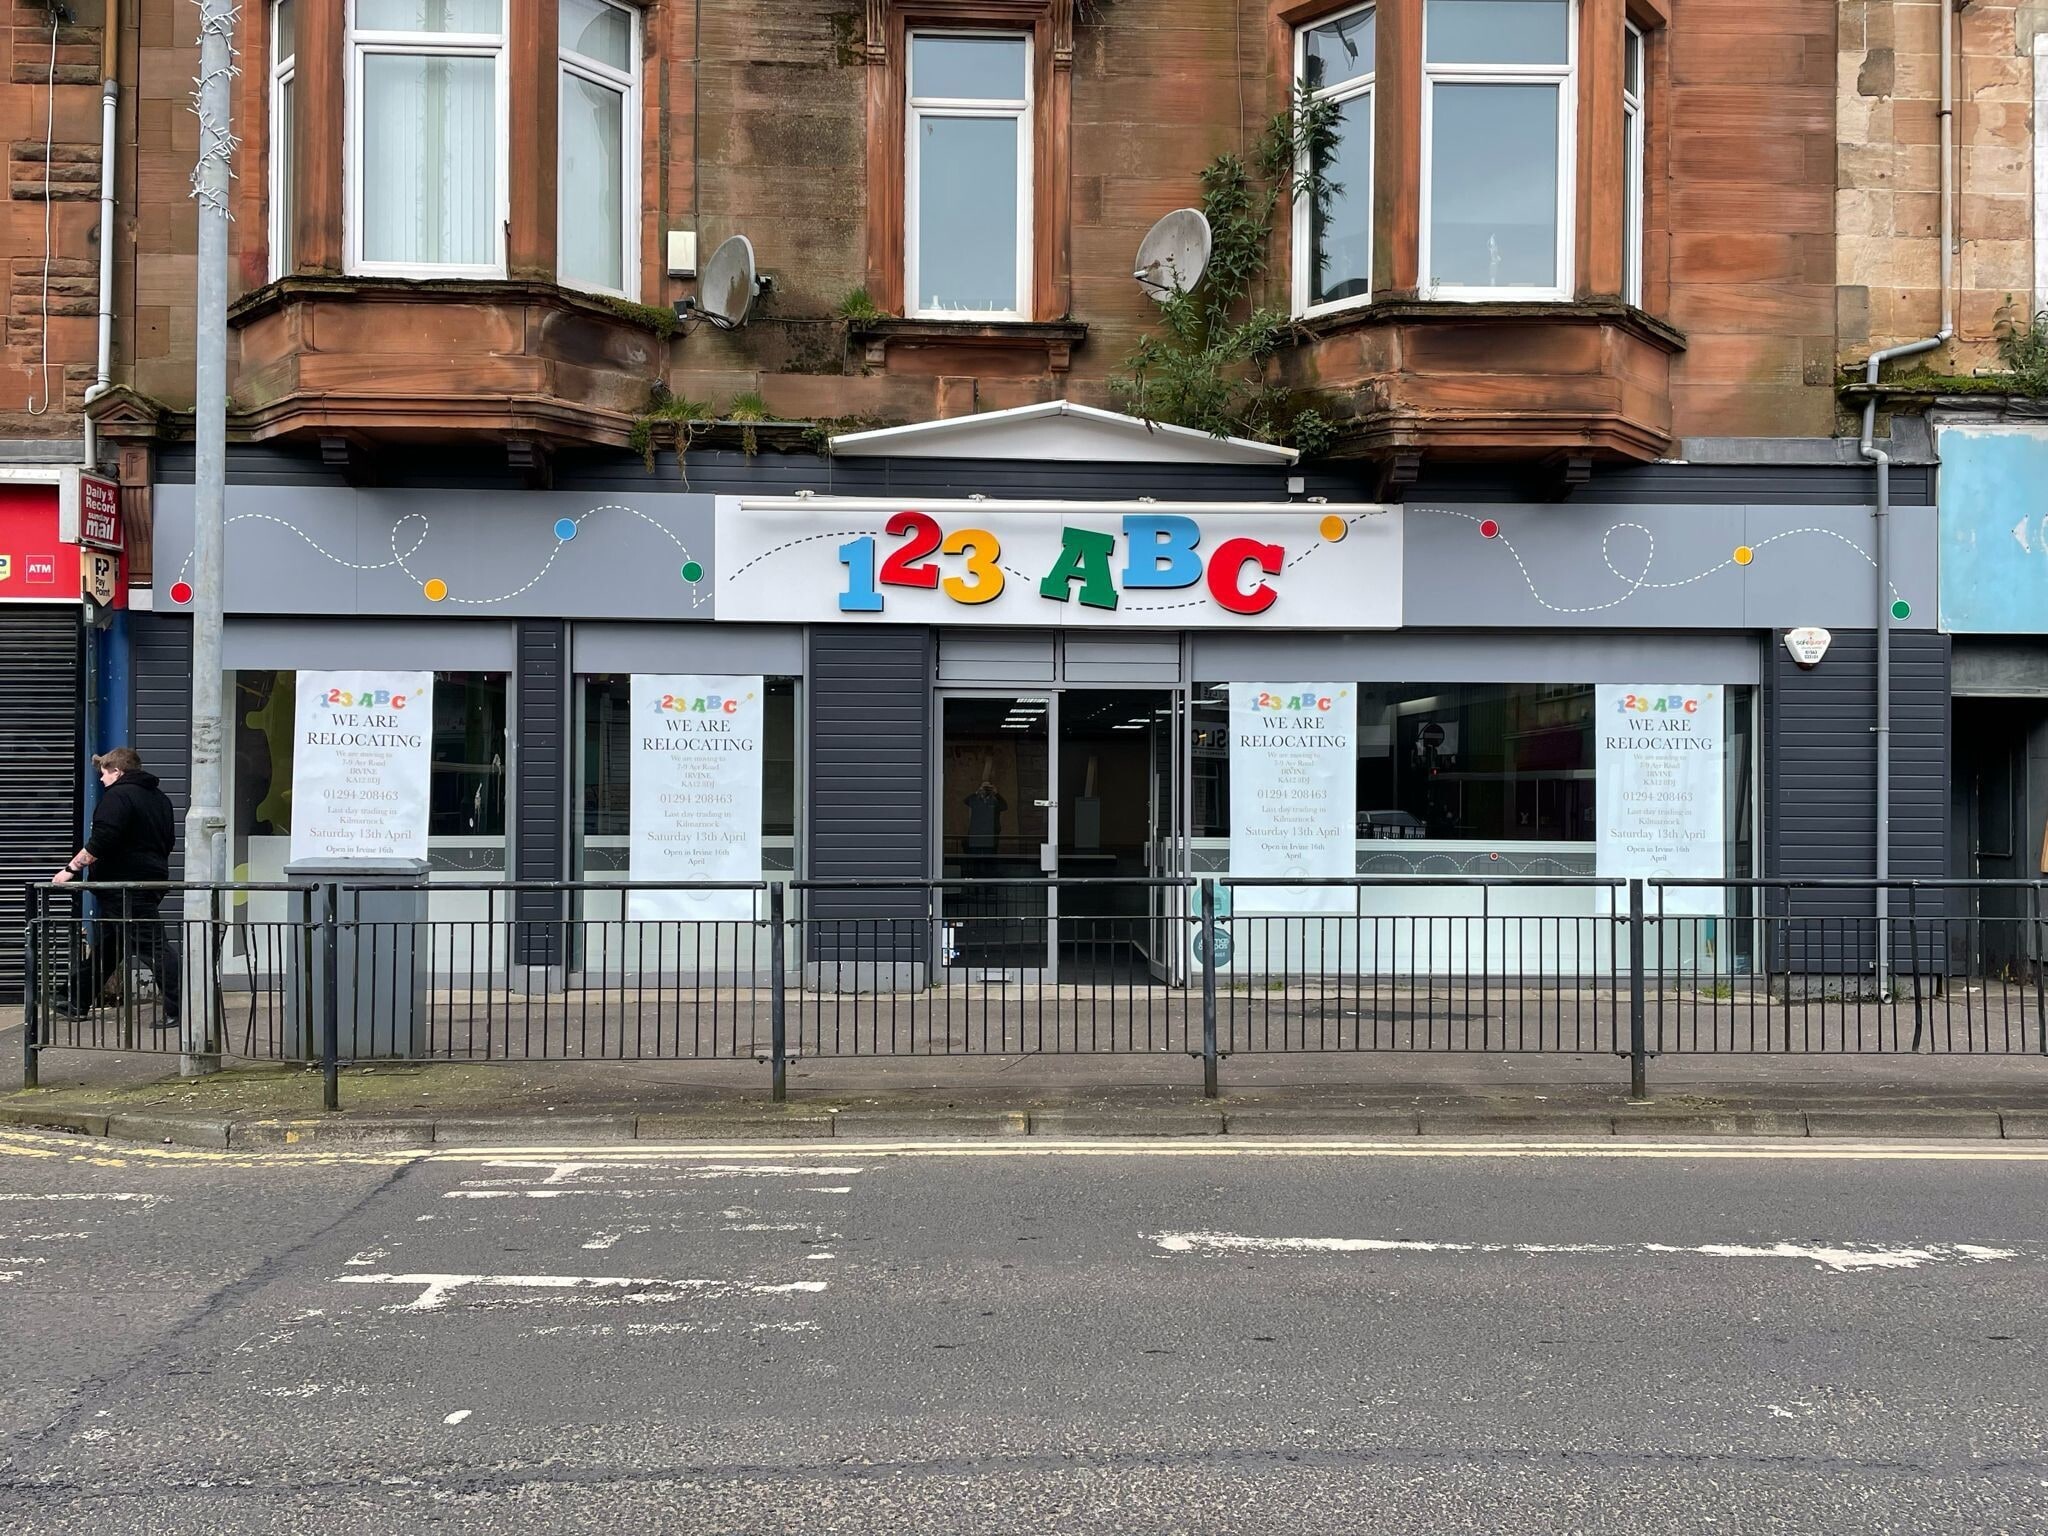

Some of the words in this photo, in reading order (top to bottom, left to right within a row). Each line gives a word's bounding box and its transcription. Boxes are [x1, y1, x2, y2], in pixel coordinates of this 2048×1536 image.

[86, 483, 107, 502] Daily
[86, 498, 116, 514] Record
[88, 512, 110, 523] sunday
[86, 518, 115, 541] mail
[29, 564, 51, 573] ATM
[838, 511, 1006, 613] 123
[1039, 515, 1286, 617] ABC
[96, 576, 105, 588] Pay
[96, 585, 110, 597] Point
[320, 688, 353, 709] 123
[359, 690, 406, 710] ABC
[654, 694, 687, 714] 123
[691, 695, 737, 714] ABC
[1251, 693, 1282, 711] 123
[1287, 693, 1332, 711] ABC
[1617, 694, 1648, 713] 123
[1653, 695, 1698, 714] ABC
[332, 714, 358, 727] WE
[363, 715, 398, 728] ARE
[666, 720, 692, 732] WE
[696, 720, 731, 732] ARE
[1263, 717, 1288, 729] WE
[1292, 717, 1325, 729] ARE
[1629, 719, 1654, 731] WE
[1658, 719, 1691, 731] ARE
[307, 732, 422, 748] RELOCATING
[643, 738, 753, 751] RELOCATING
[1240, 735, 1346, 748] RELOCATING
[1606, 737, 1712, 750] RELOCATING
[336, 750, 344, 758] We
[323, 790, 356, 799] 01294
[360, 790, 399, 800] 208463
[659, 794, 691, 804] 01294
[695, 794, 733, 804] 208463
[1257, 789, 1287, 799] 01294
[1291, 789, 1327, 799] 208463
[1623, 792, 1653, 801] 01294
[1657, 792, 1693, 801] 208463
[345, 807, 358, 815] day
[361, 808, 388, 816] trading
[681, 810, 694, 819] day
[696, 810, 722, 819] trading
[1278, 805, 1290, 814] day
[1293, 806, 1318, 814] trading
[1643, 808, 1656, 816] day
[1658, 808, 1683, 816] trading
[340, 817, 384, 825] Kilmarnock
[310, 828, 355, 840] Saturday
[360, 829, 381, 839] 13th
[385, 830, 411, 842] April
[648, 831, 692, 843] Saturday
[696, 831, 718, 841] 13th
[720, 832, 746, 843] April
[1245, 827, 1288, 839] Saturday
[1293, 827, 1313, 836] 13th
[1316, 827, 1340, 838] April
[1610, 828, 1653, 840] Saturday
[1658, 829, 1678, 838] 13th
[1681, 829, 1706, 840] April
[326, 845, 345, 854] Open
[663, 849, 682, 857] Open
[1261, 843, 1279, 851] Open
[1626, 845, 1645, 853] Open
[1655, 845, 1673, 853] Irvine
[688, 858, 705, 867] April
[1650, 855, 1667, 863] April
